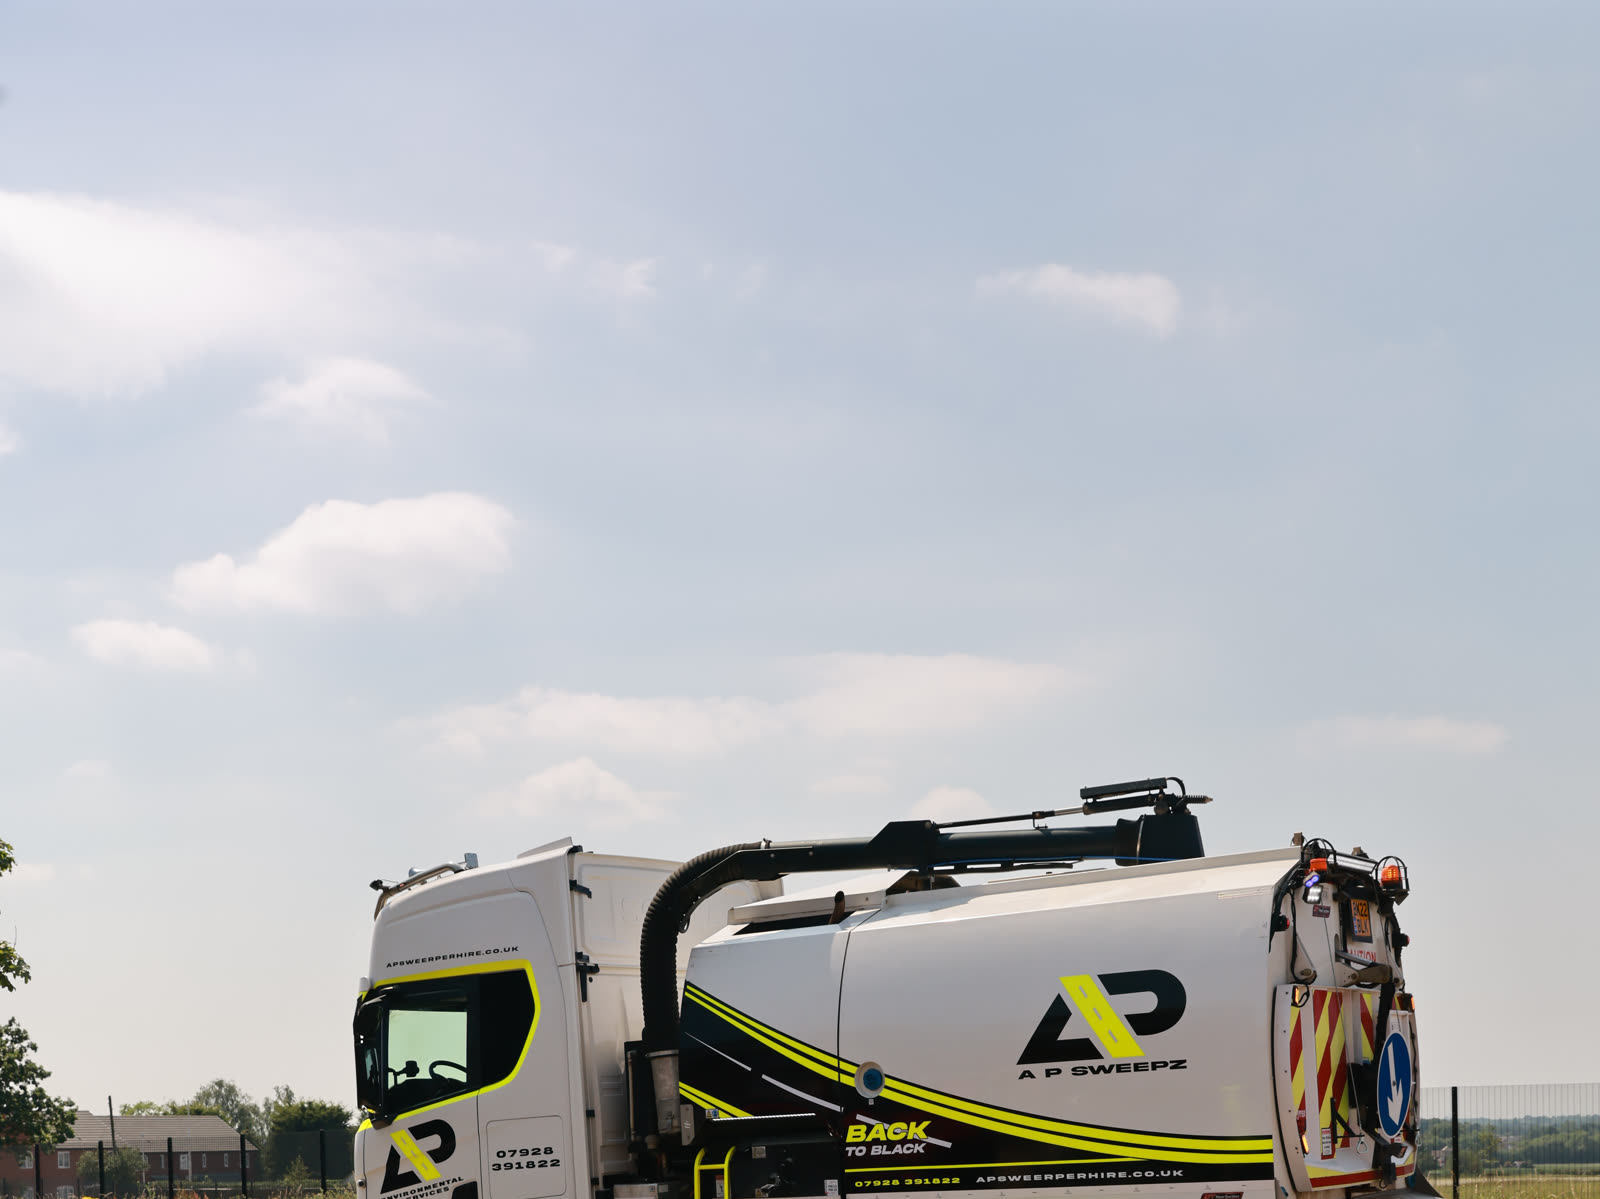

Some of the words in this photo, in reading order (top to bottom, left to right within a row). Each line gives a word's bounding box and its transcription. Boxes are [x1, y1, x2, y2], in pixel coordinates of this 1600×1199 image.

[386, 946, 519, 968] APSWEERPERHIRE.CO.UK
[1018, 1070, 1036, 1080] A
[1045, 1068, 1062, 1078] P
[1071, 1059, 1187, 1076] SWEEPZ
[845, 1120, 932, 1143] BACK
[496, 1146, 554, 1159] 07928
[845, 1145, 866, 1157] TO
[870, 1142, 927, 1156] BLACK
[491, 1159, 561, 1171] 391822
[854, 1179, 900, 1188] 07928
[904, 1177, 961, 1185] 391822
[975, 1169, 1184, 1183] APSWEERPERHIRE.CO.UK
